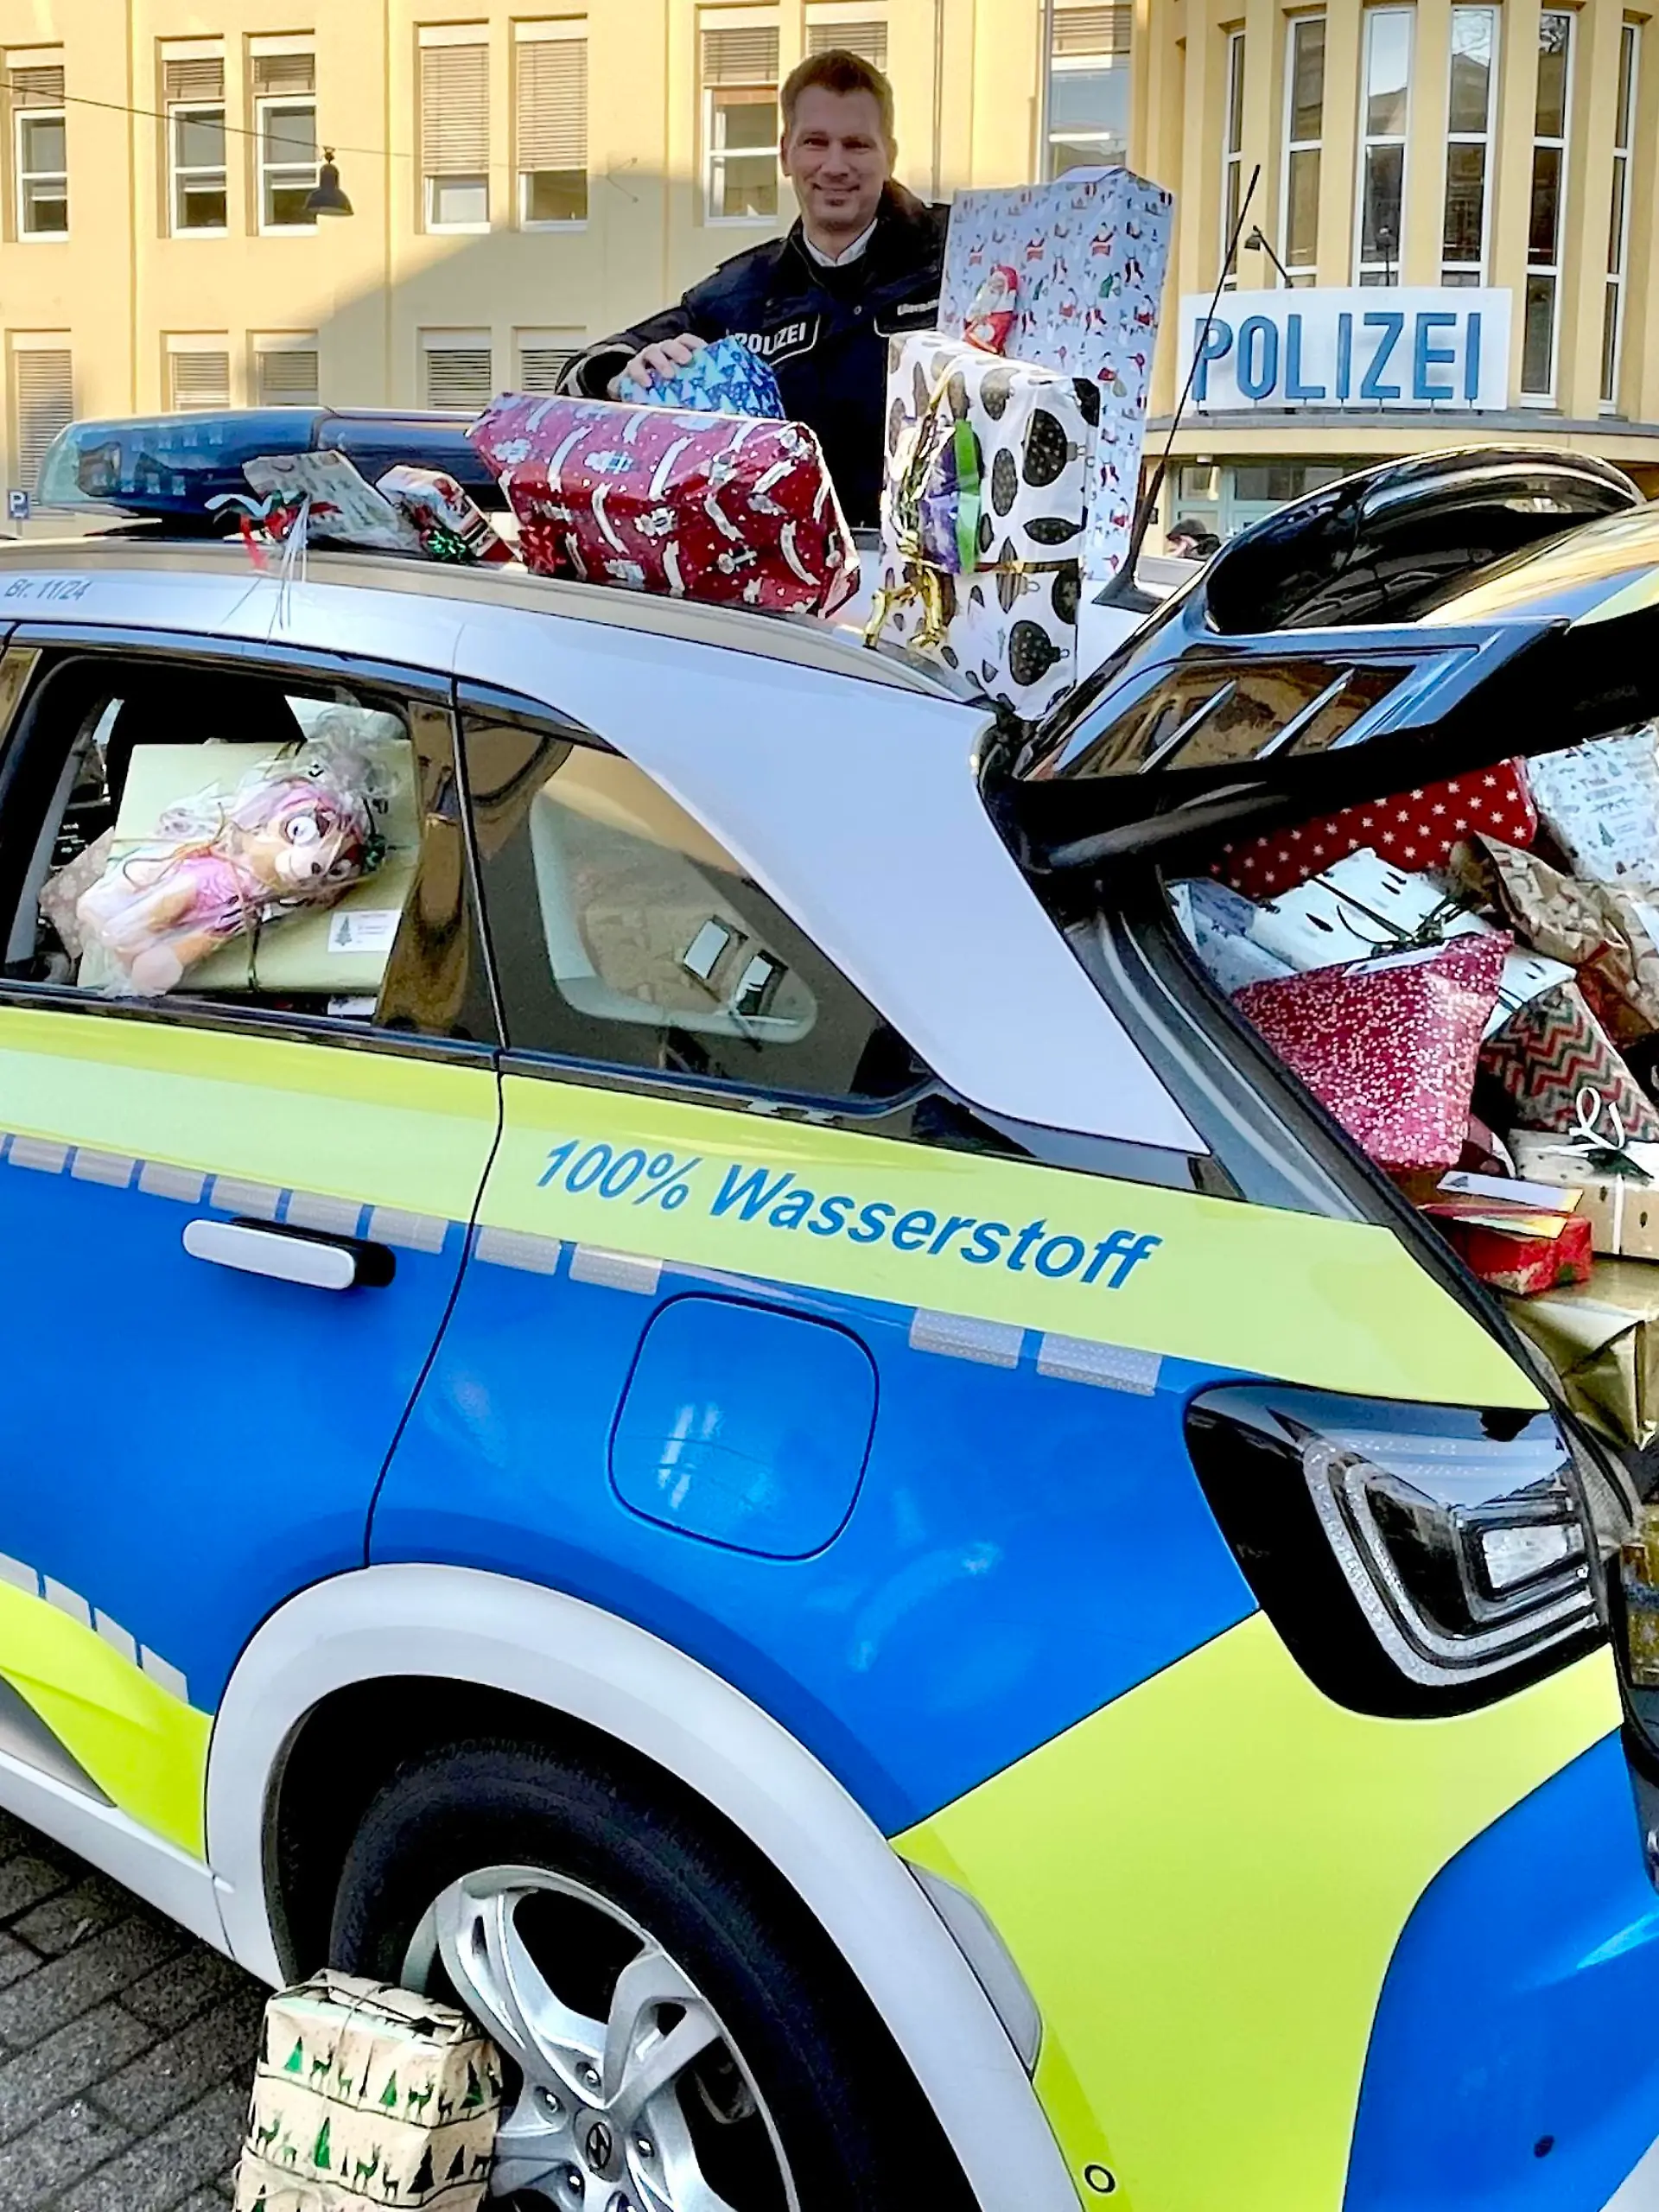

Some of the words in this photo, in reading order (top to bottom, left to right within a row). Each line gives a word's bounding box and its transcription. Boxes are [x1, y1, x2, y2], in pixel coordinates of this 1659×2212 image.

[1192, 312, 1482, 400] POLIZEI
[10, 492, 24, 511] P
[37, 580, 92, 601] 11/24
[537, 1139, 702, 1210] 100%
[710, 1164, 1163, 1290] Wasserstoff
